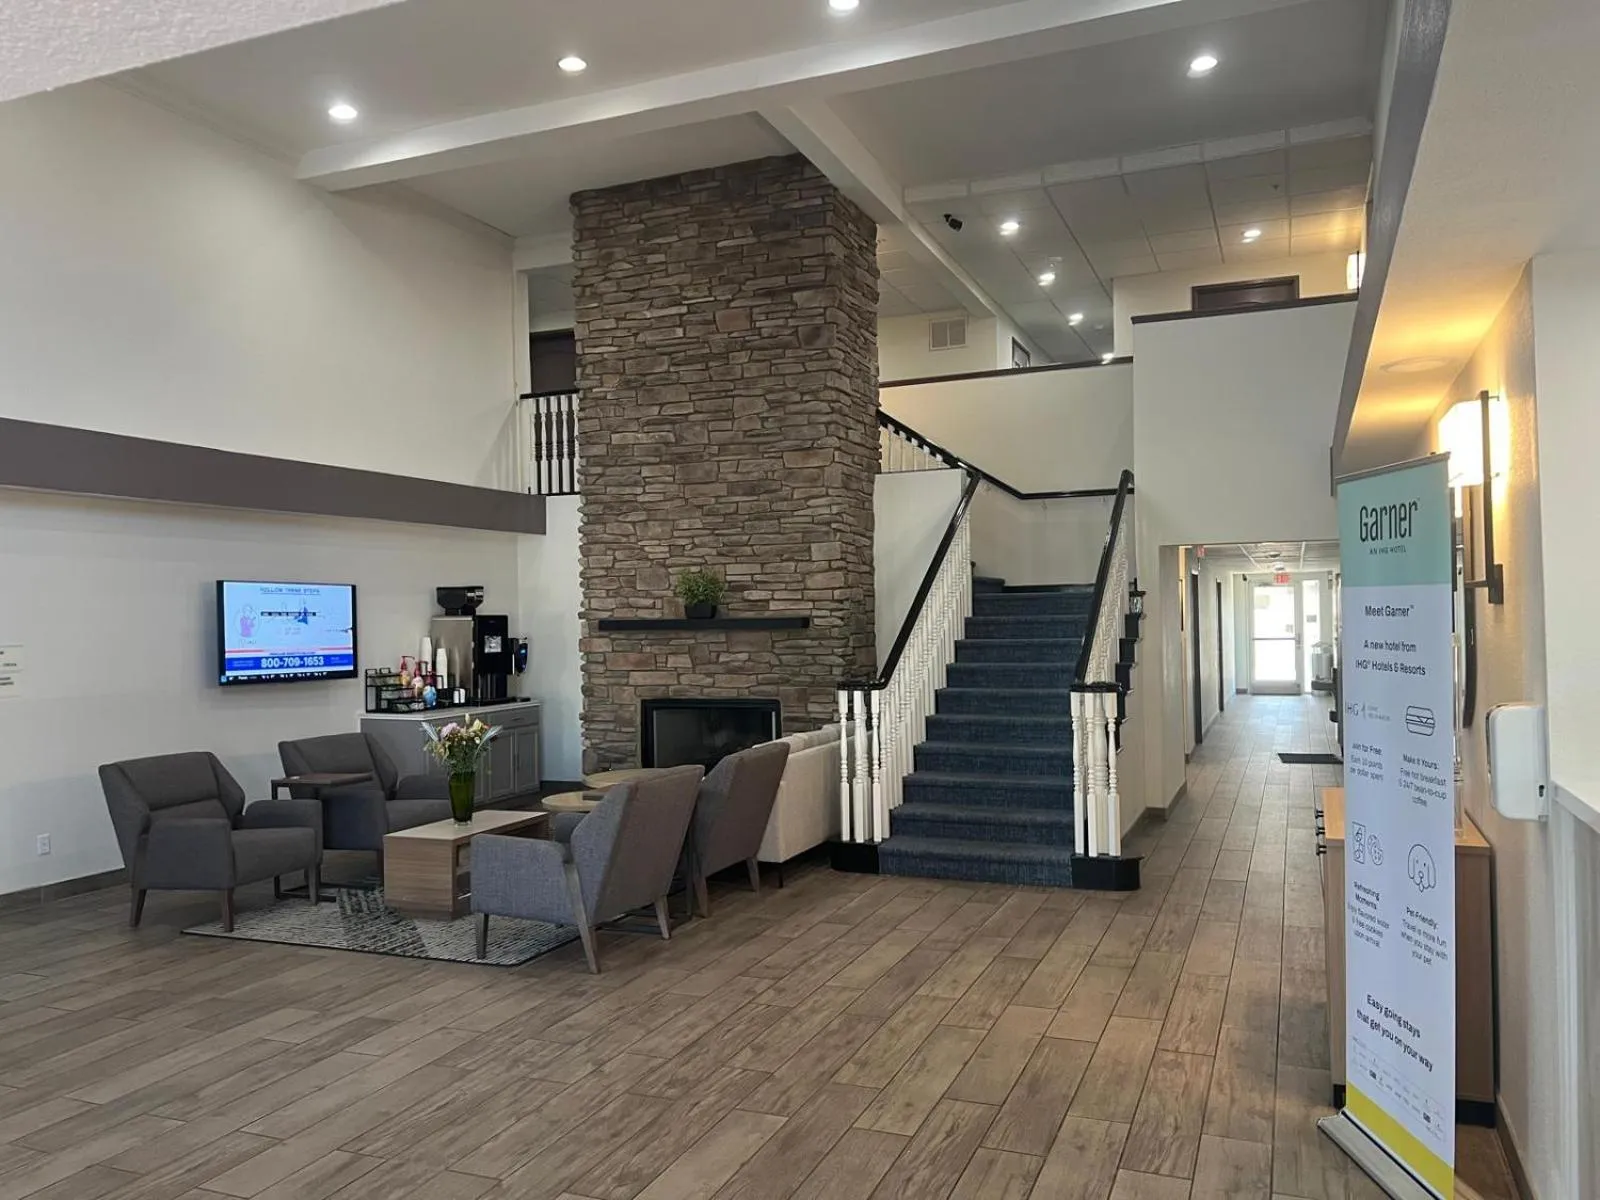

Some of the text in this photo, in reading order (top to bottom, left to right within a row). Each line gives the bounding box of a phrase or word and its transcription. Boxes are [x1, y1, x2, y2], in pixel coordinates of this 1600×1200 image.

[1360, 500, 1418, 542] Garner
[1365, 605, 1384, 617] Meet
[1364, 640, 1417, 653] A new hotel from
[261, 656, 324, 669] 800-709-1653
[1372, 661, 1393, 672] Hotels
[1394, 662, 1399, 673] &
[1400, 663, 1426, 676] Resorts
[1367, 994, 1421, 1039] Easy going stays
[1357, 1009, 1434, 1073] that get you on your way
